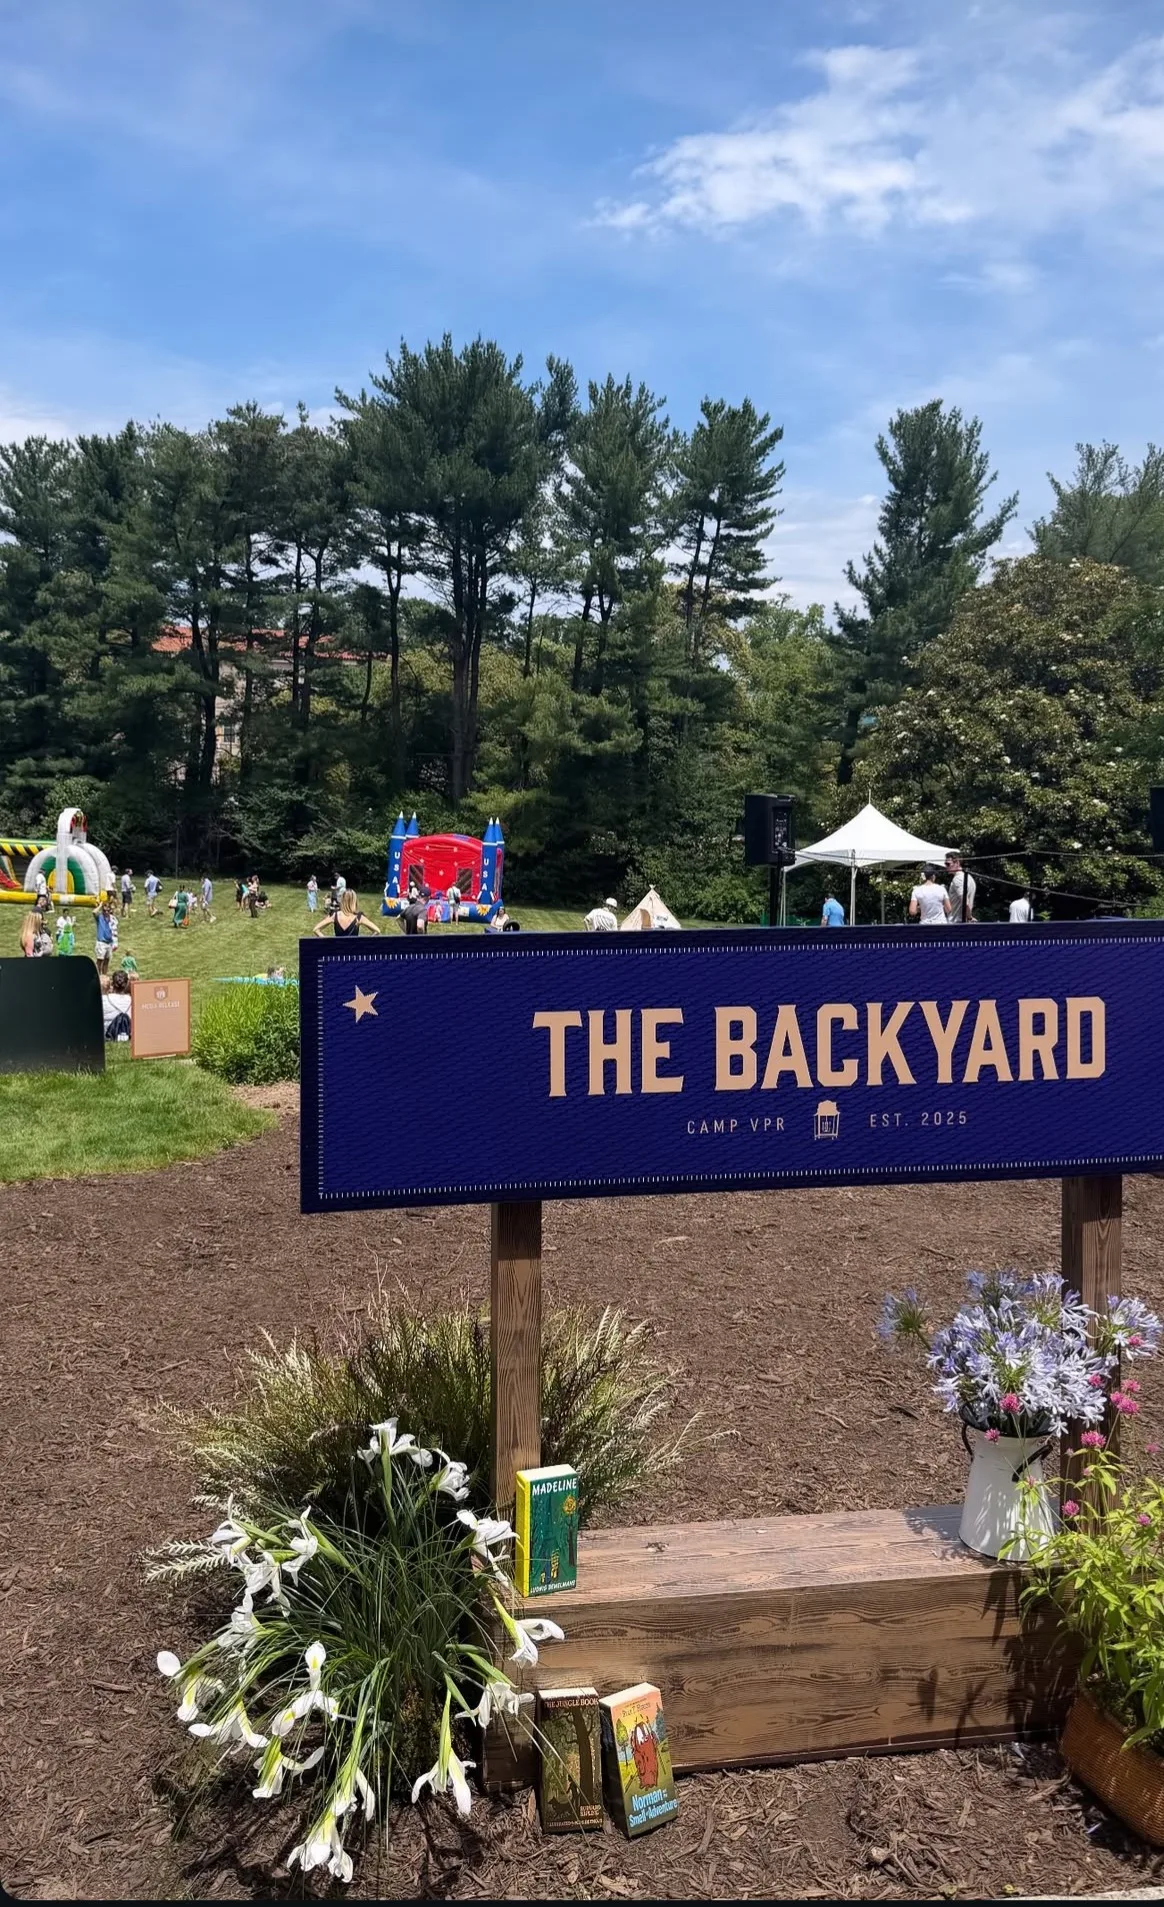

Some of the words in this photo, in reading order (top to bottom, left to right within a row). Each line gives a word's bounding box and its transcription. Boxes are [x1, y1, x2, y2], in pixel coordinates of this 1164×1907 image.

[392, 851, 400, 884] USA
[481, 858, 489, 891] USA
[532, 1007, 684, 1097] THE
[714, 996, 1106, 1092] BACKYARD
[687, 1118, 738, 1135] CAMP
[750, 1116, 785, 1132] VPR
[870, 1112, 909, 1128] EST.
[921, 1110, 967, 1126] 2025
[532, 1478, 577, 1496] MADELINE
[556, 1699, 580, 1708] JUNGLE
[580, 1697, 598, 1706] BOOK
[632, 1788, 663, 1811] Norman
[629, 1809, 647, 1828] Smell
[649, 1799, 678, 1819] Adventure
